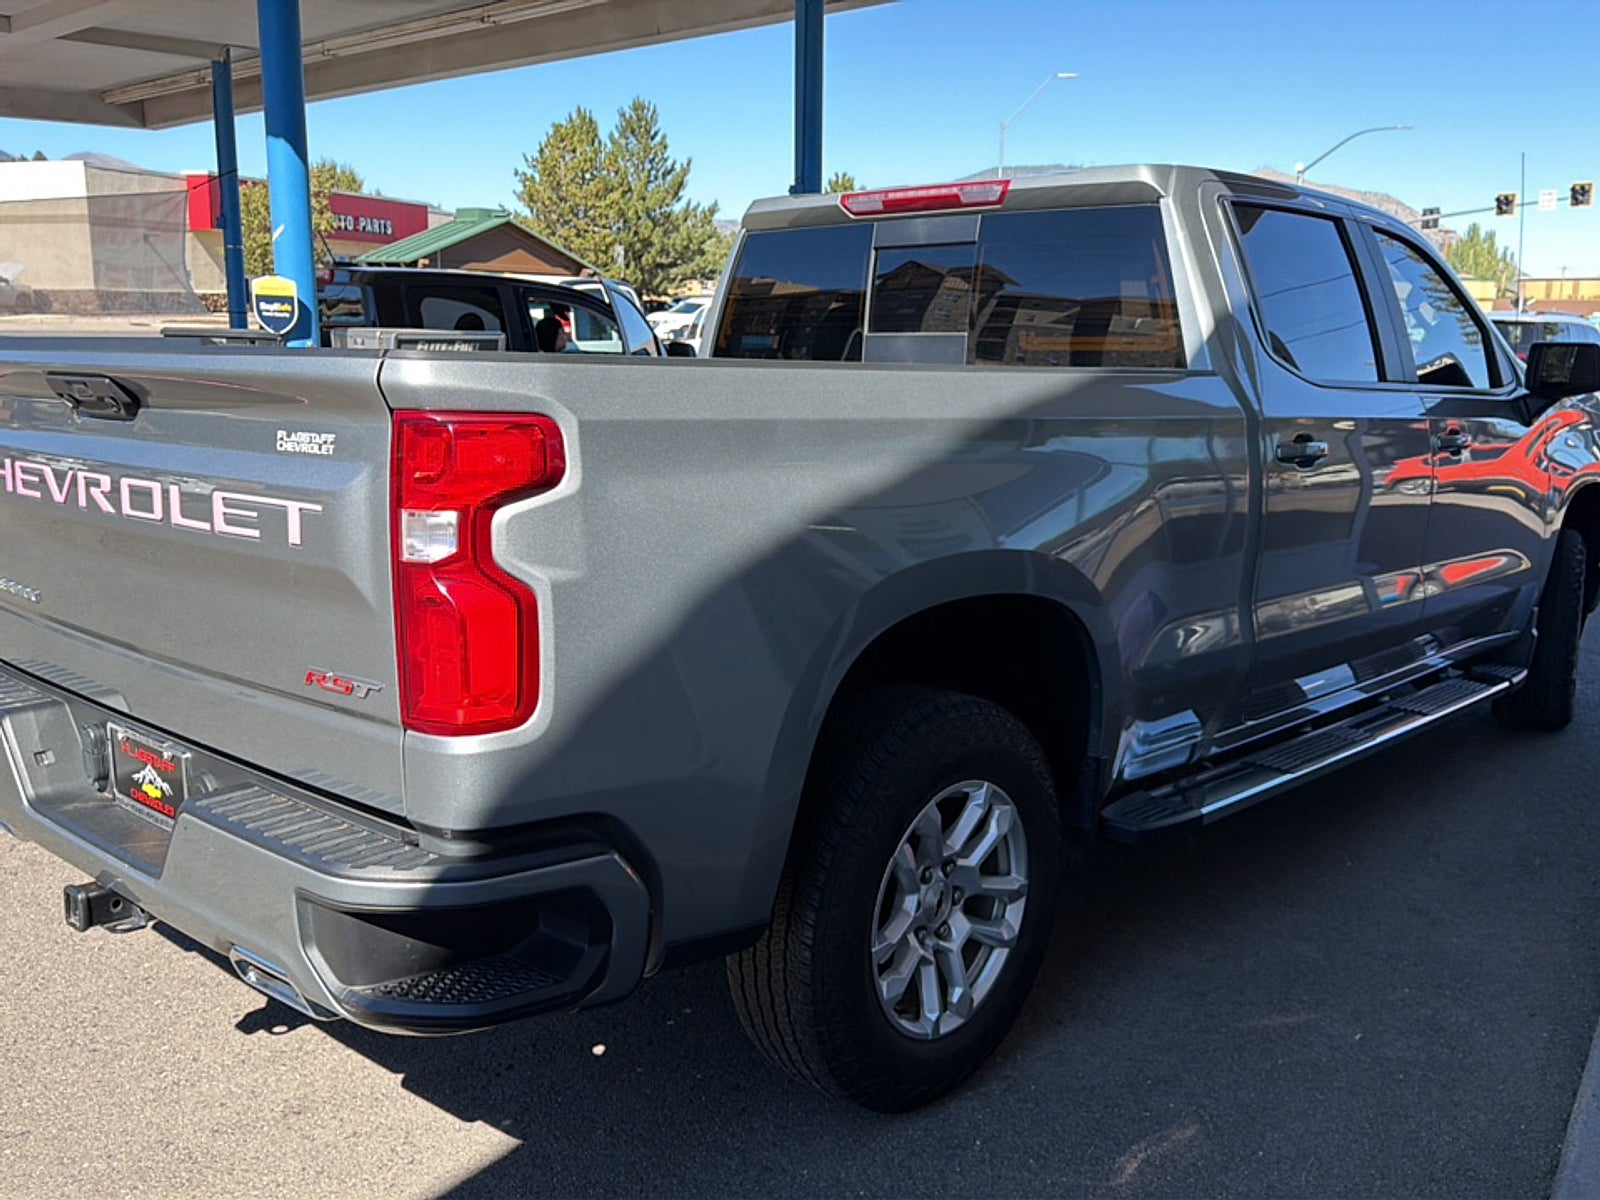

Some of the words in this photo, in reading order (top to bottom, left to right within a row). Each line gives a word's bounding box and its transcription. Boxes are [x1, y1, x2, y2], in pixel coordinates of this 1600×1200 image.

[333, 213, 355, 230] UTO
[358, 216, 393, 235] PARTS
[276, 430, 336, 443] FLAGSTAFF
[276, 440, 335, 455] CHEVROLET
[0, 458, 323, 547] HEVROLET
[304, 667, 385, 699] RST
